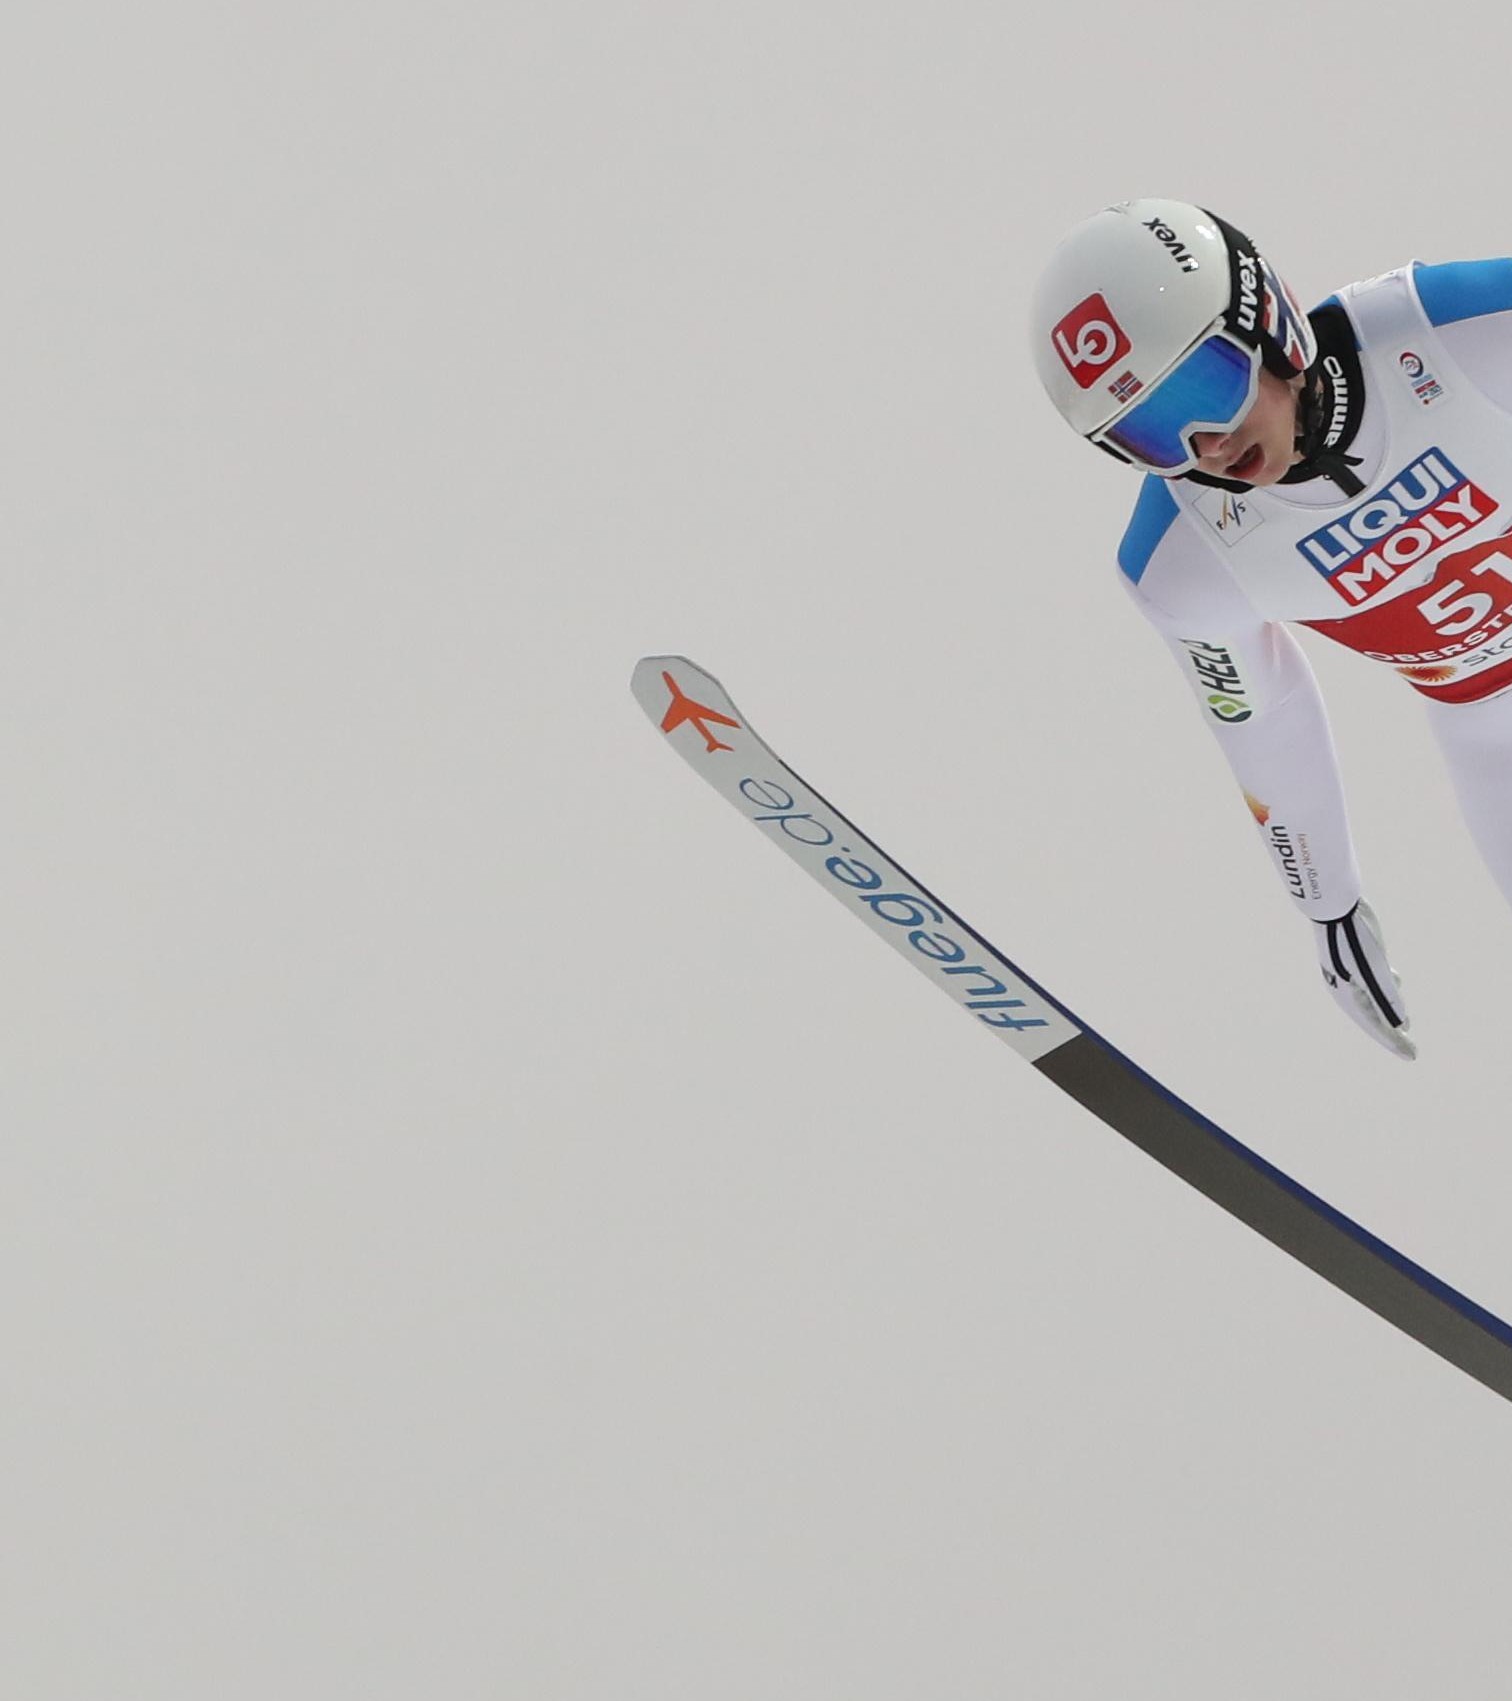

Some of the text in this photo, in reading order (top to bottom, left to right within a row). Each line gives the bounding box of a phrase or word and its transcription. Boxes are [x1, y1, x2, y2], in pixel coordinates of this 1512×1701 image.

[1142, 217, 1199, 273] uvex
[1237, 250, 1258, 331] uvex
[1304, 454, 1458, 571] LIQUI
[1336, 484, 1483, 601] MOLY
[1178, 638, 1246, 695] HELP
[1270, 825, 1306, 899] Lundin
[739, 778, 1049, 1032] fluege.de
